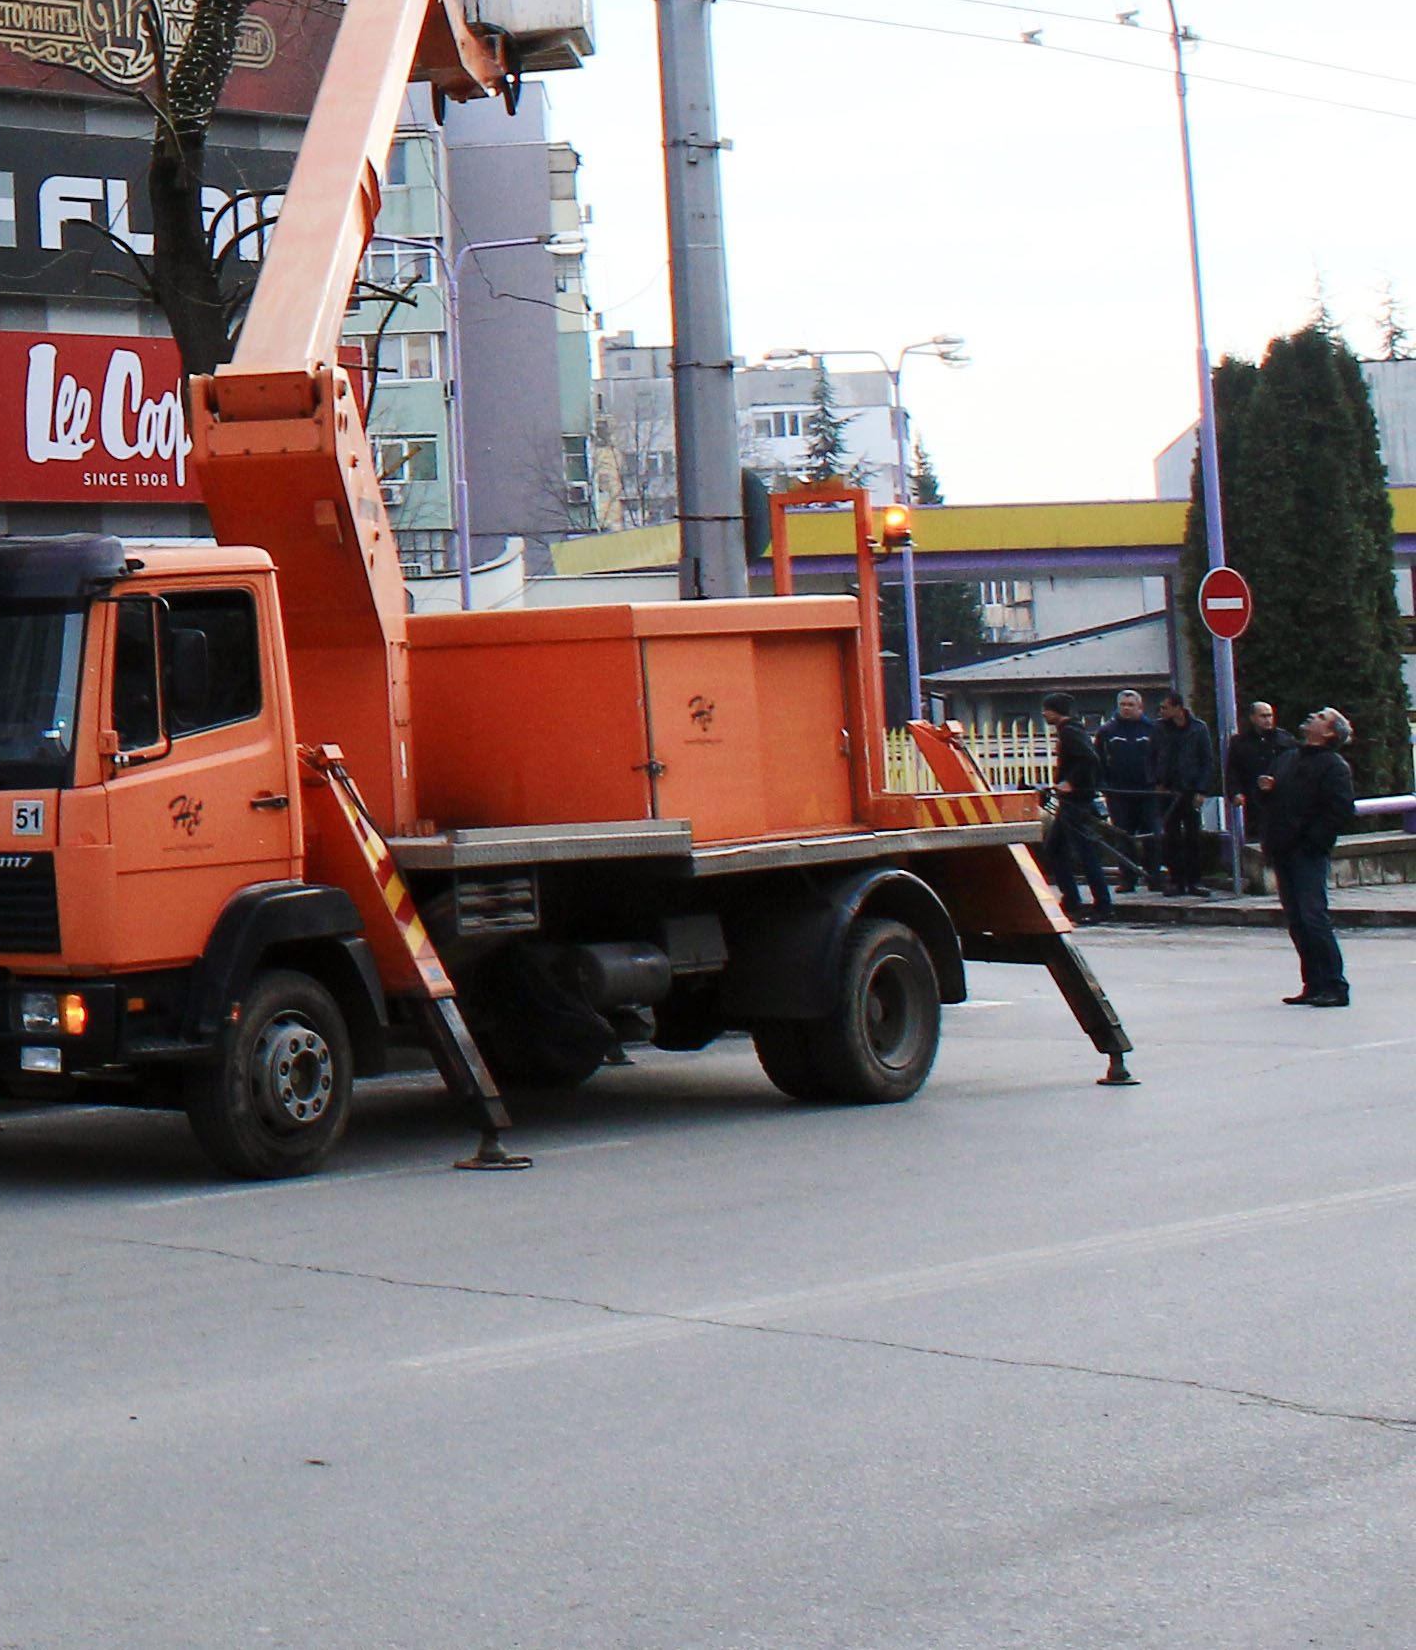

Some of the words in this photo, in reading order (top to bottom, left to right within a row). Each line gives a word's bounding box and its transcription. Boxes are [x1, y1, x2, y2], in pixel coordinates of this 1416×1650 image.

[26, 342, 96, 463] Lee
[100, 348, 194, 487] Coop
[83, 471, 128, 487] SINCE
[134, 472, 169, 487] 1908
[16, 807, 39, 829] 51
[0, 855, 33, 869] 1117
